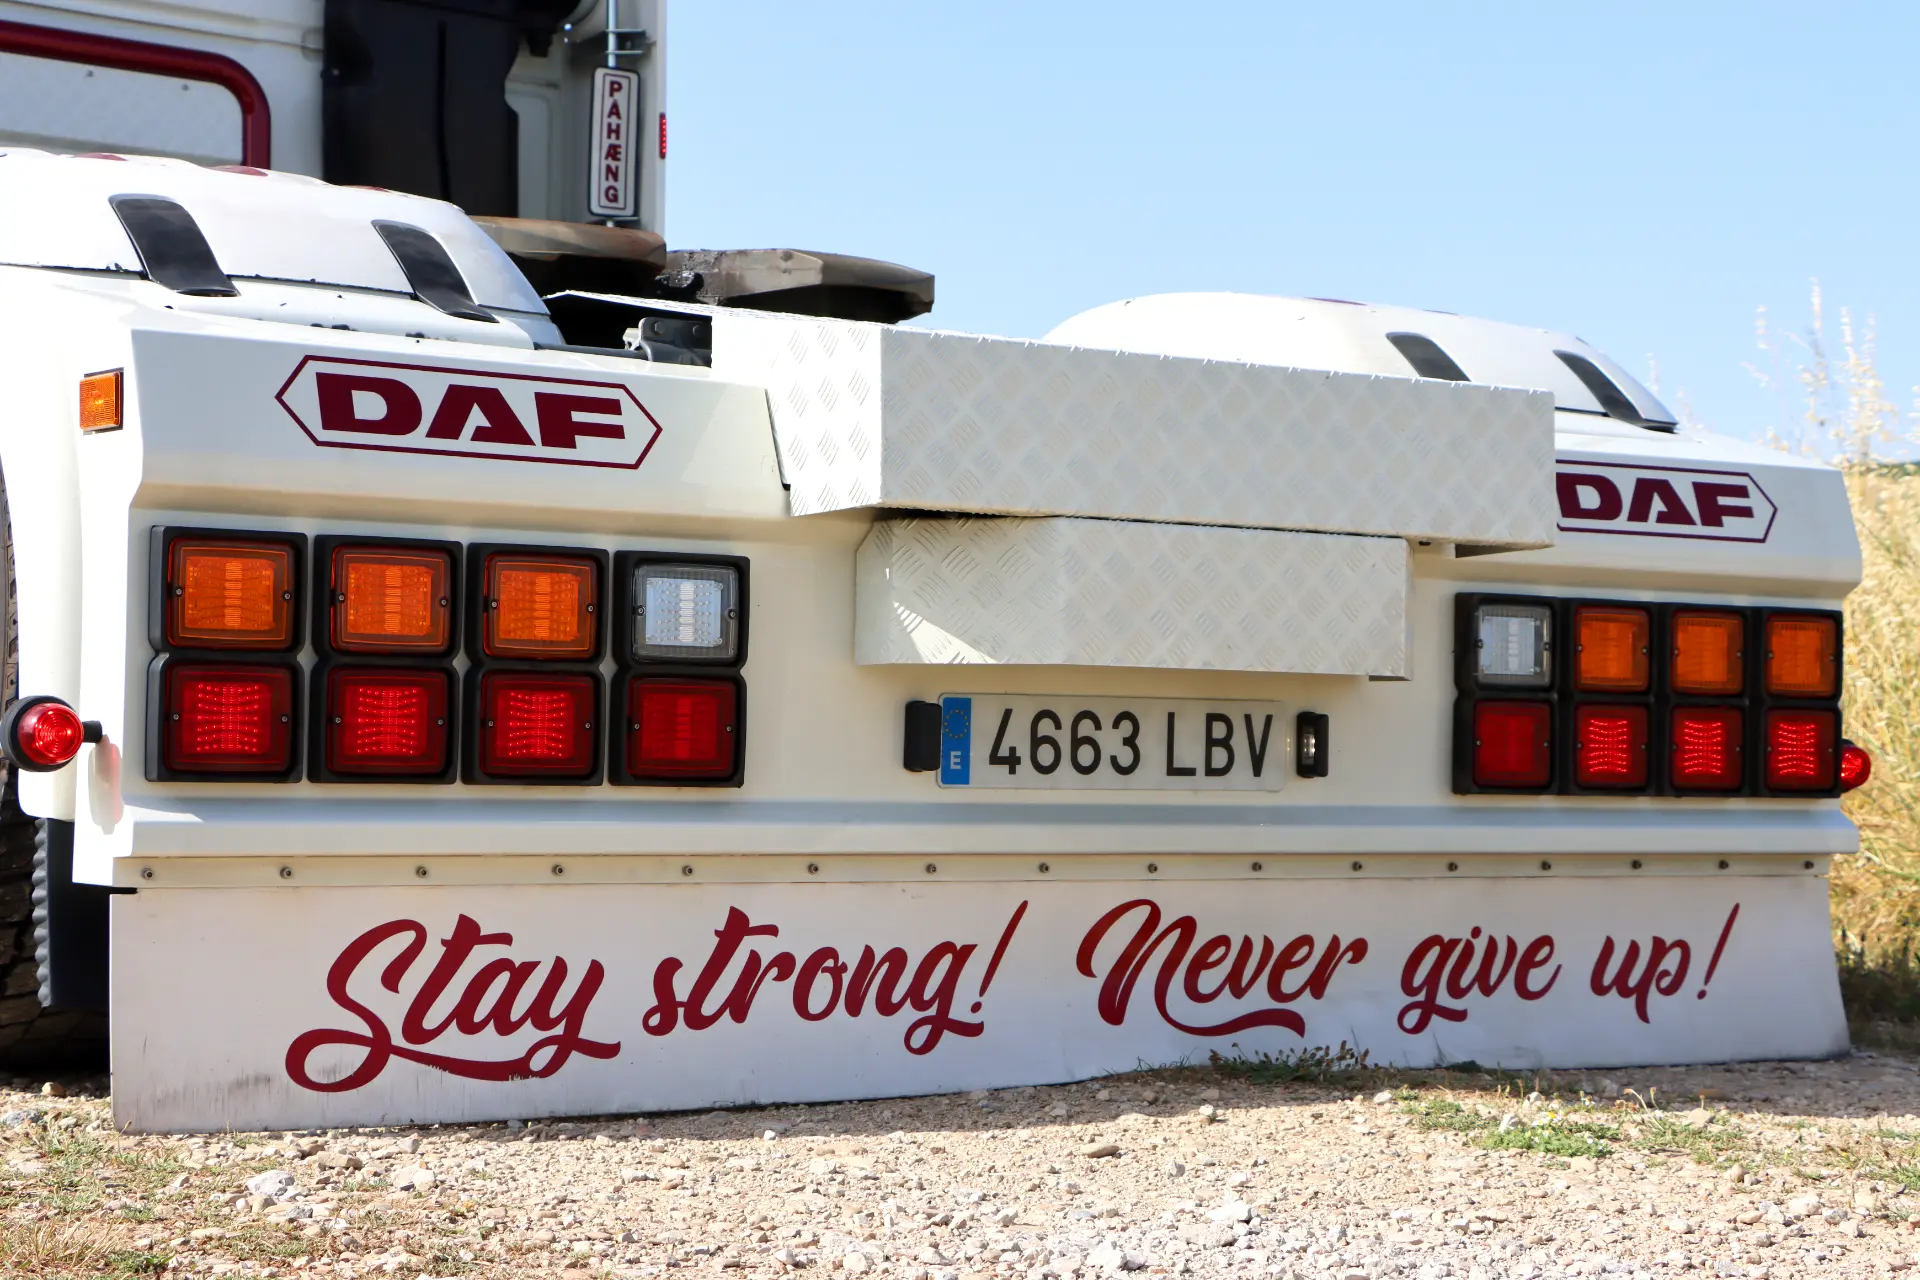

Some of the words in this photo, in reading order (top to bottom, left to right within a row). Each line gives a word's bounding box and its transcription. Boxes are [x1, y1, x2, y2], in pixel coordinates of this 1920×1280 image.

[315, 372, 626, 449] DAF
[1556, 472, 1755, 527] DAF
[950, 750, 962, 770] E
[988, 708, 1142, 776] 4663
[1166, 711, 1274, 778] LBV
[285, 913, 621, 1093] Stay
[642, 900, 1029, 1056] strong!
[1076, 898, 1368, 1038] Never
[1397, 926, 1563, 1035] give
[1590, 902, 1741, 1024] up!
